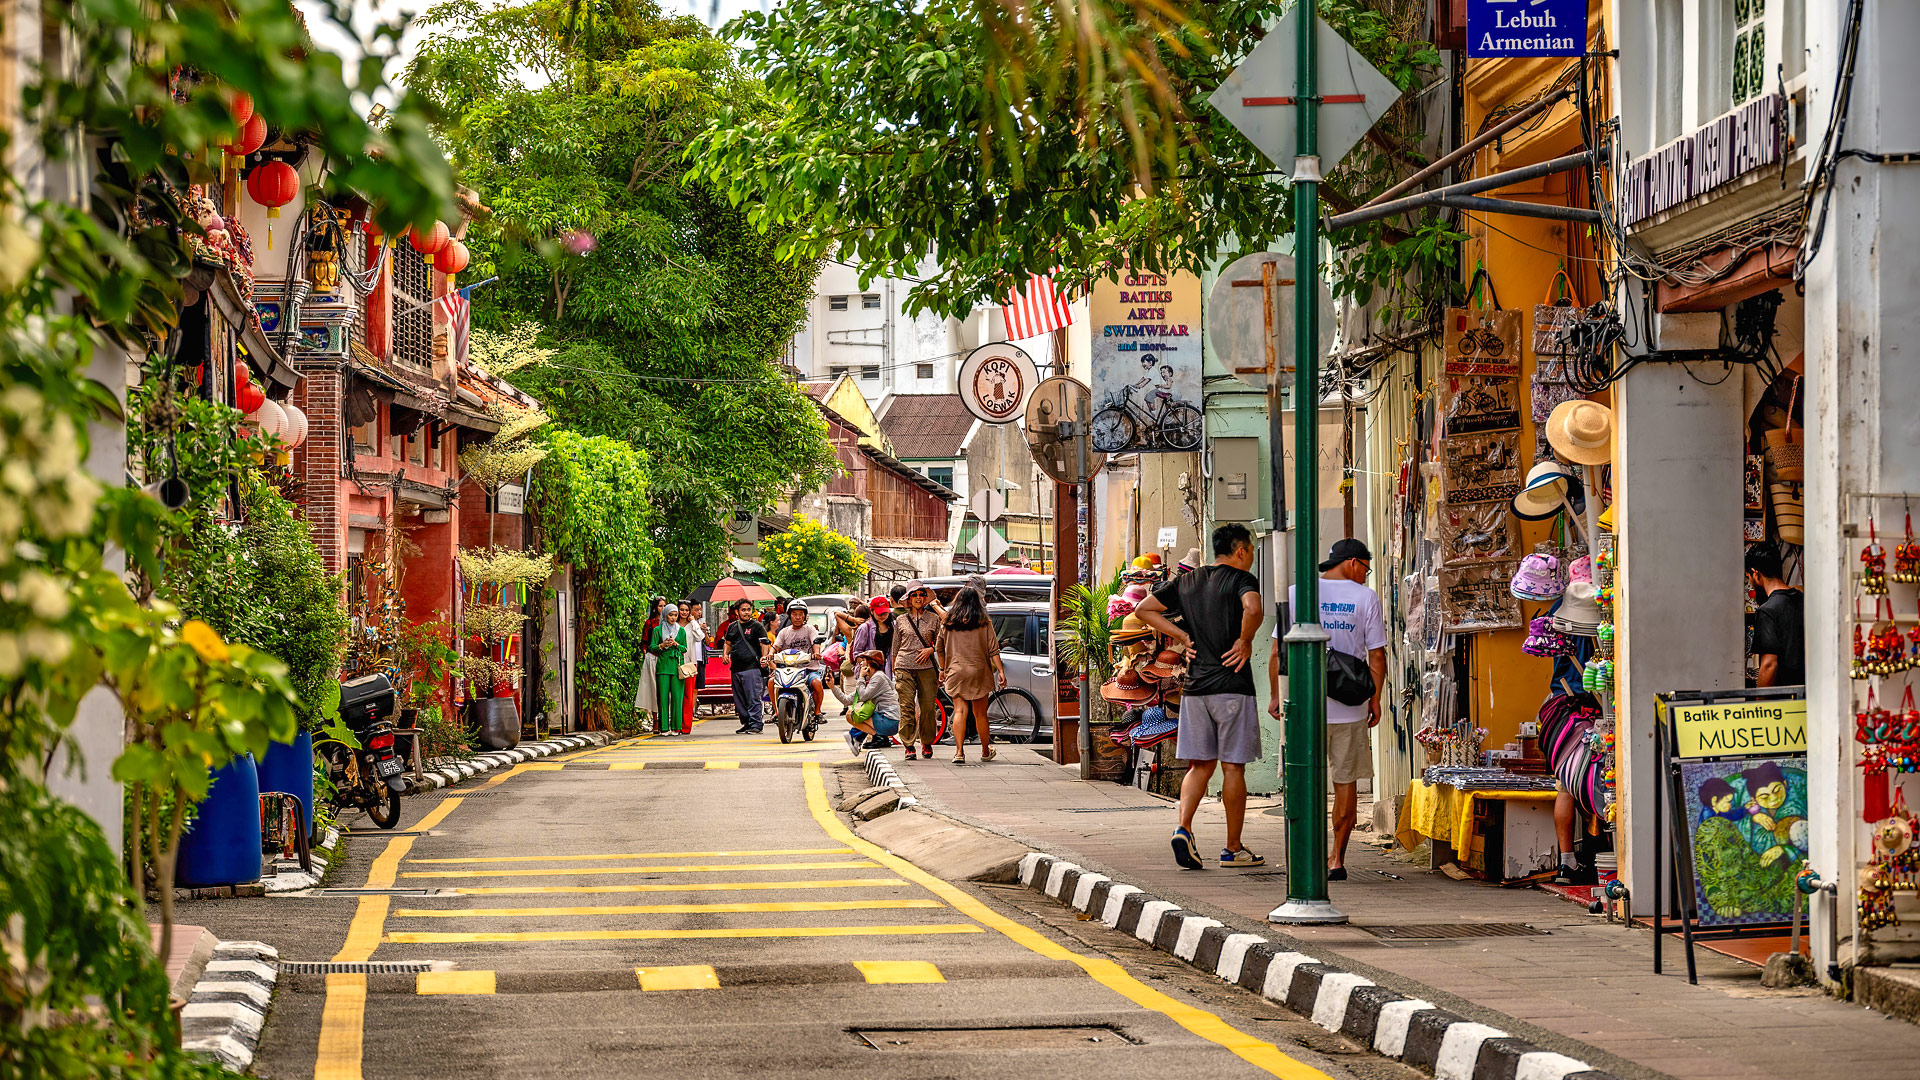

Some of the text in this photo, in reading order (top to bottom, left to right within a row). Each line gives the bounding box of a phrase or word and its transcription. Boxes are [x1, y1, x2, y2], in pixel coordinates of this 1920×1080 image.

[1495, 9, 1557, 28] Lebuh
[1478, 31, 1575, 50] Armenian
[1622, 93, 1776, 228] BATIK PAINTING MUSEUM PENANG
[1125, 274, 1167, 286] GIFTS
[1120, 291, 1172, 303] BATIKS
[1127, 308, 1165, 320] ARTS
[1103, 324, 1189, 337] SWIMWEAR
[1118, 341, 1137, 351] and
[983, 361, 1010, 375] KOPI
[982, 390, 1016, 412] LOEWAK
[1323, 620, 1356, 632] holiday
[1683, 707, 1782, 722] Batik Painting
[1700, 725, 1807, 750] MUSEUM
[383, 760, 397, 768] PPE
